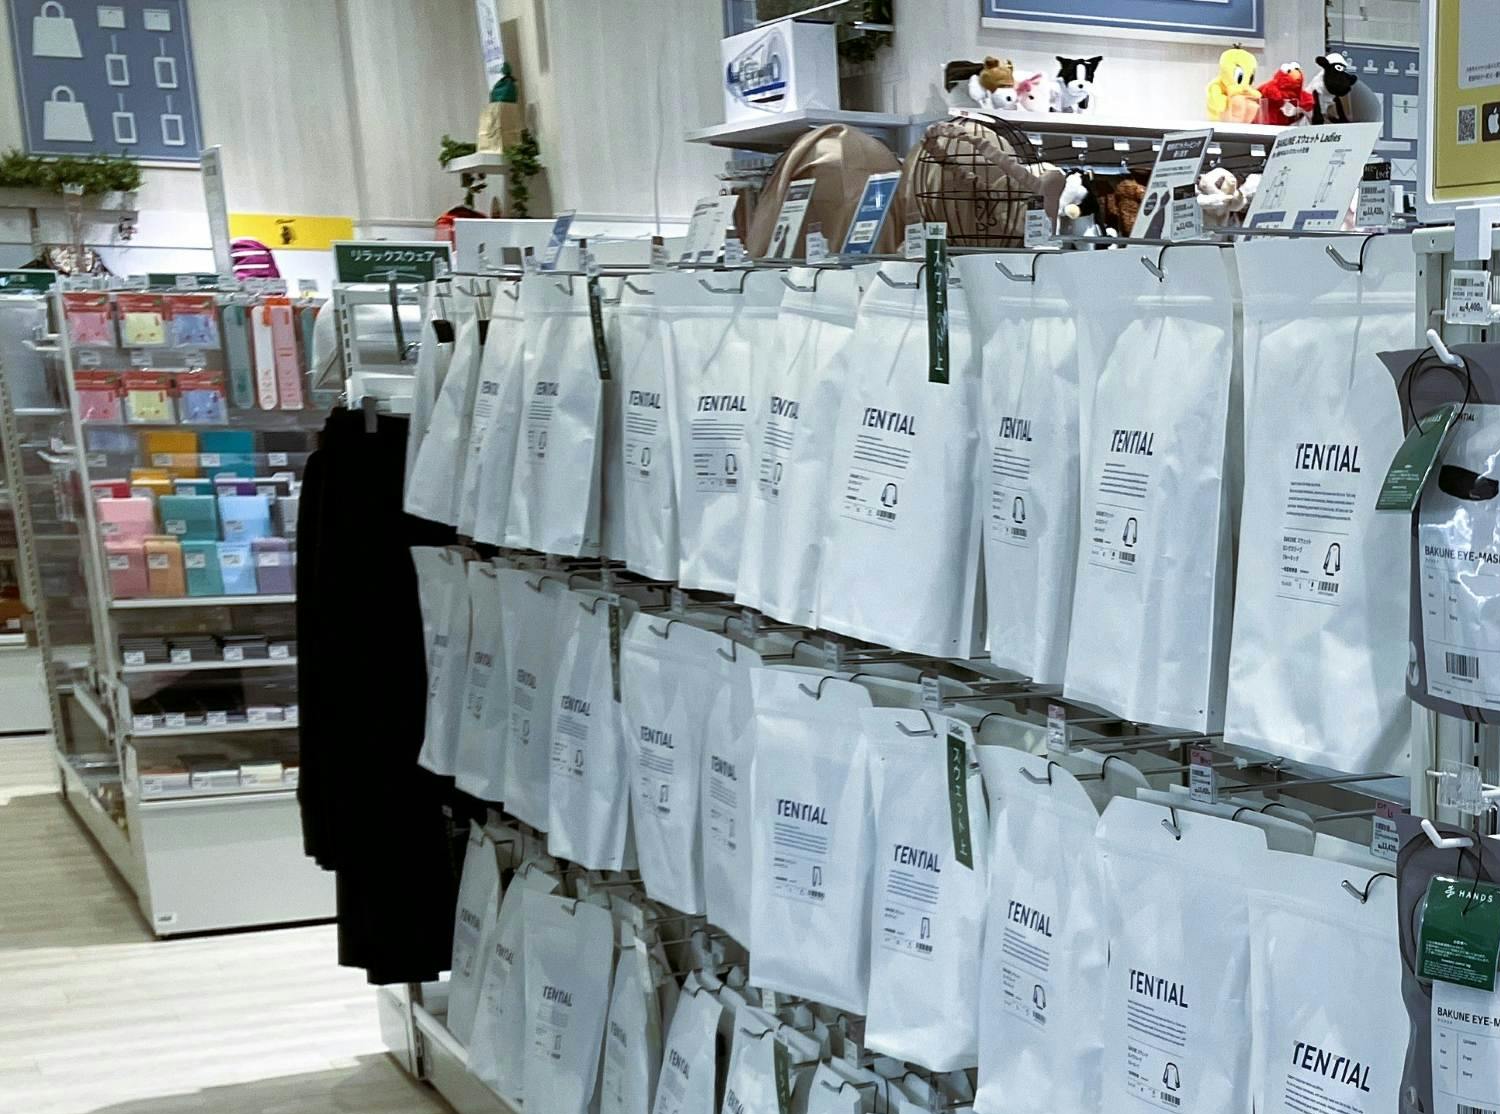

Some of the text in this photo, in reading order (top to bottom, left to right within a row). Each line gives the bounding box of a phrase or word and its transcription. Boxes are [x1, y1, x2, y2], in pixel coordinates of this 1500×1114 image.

[350, 249, 435, 261] リラックスウェア
[697, 395, 747, 413] TENTIAL
[862, 407, 917, 437] TENTIAL
[999, 416, 1033, 443] TENTIAL
[1111, 429, 1155, 457] TENTIAL
[1295, 442, 1361, 473] TENTIAL
[1424, 545, 1456, 560] BAKUNE
[639, 725, 674, 750] TENTIAL
[775, 798, 828, 825] TENTIAL
[952, 747, 968, 856] スウェット上
[893, 844, 941, 874] TENTIAL
[1458, 890, 1494, 903] HANDS
[1007, 899, 1053, 938] TENTIAL
[1128, 968, 1188, 1009] TENTIAL
[1437, 1006, 1471, 1023] BAKUNE
[1292, 1040, 1370, 1092] TENTIAL
